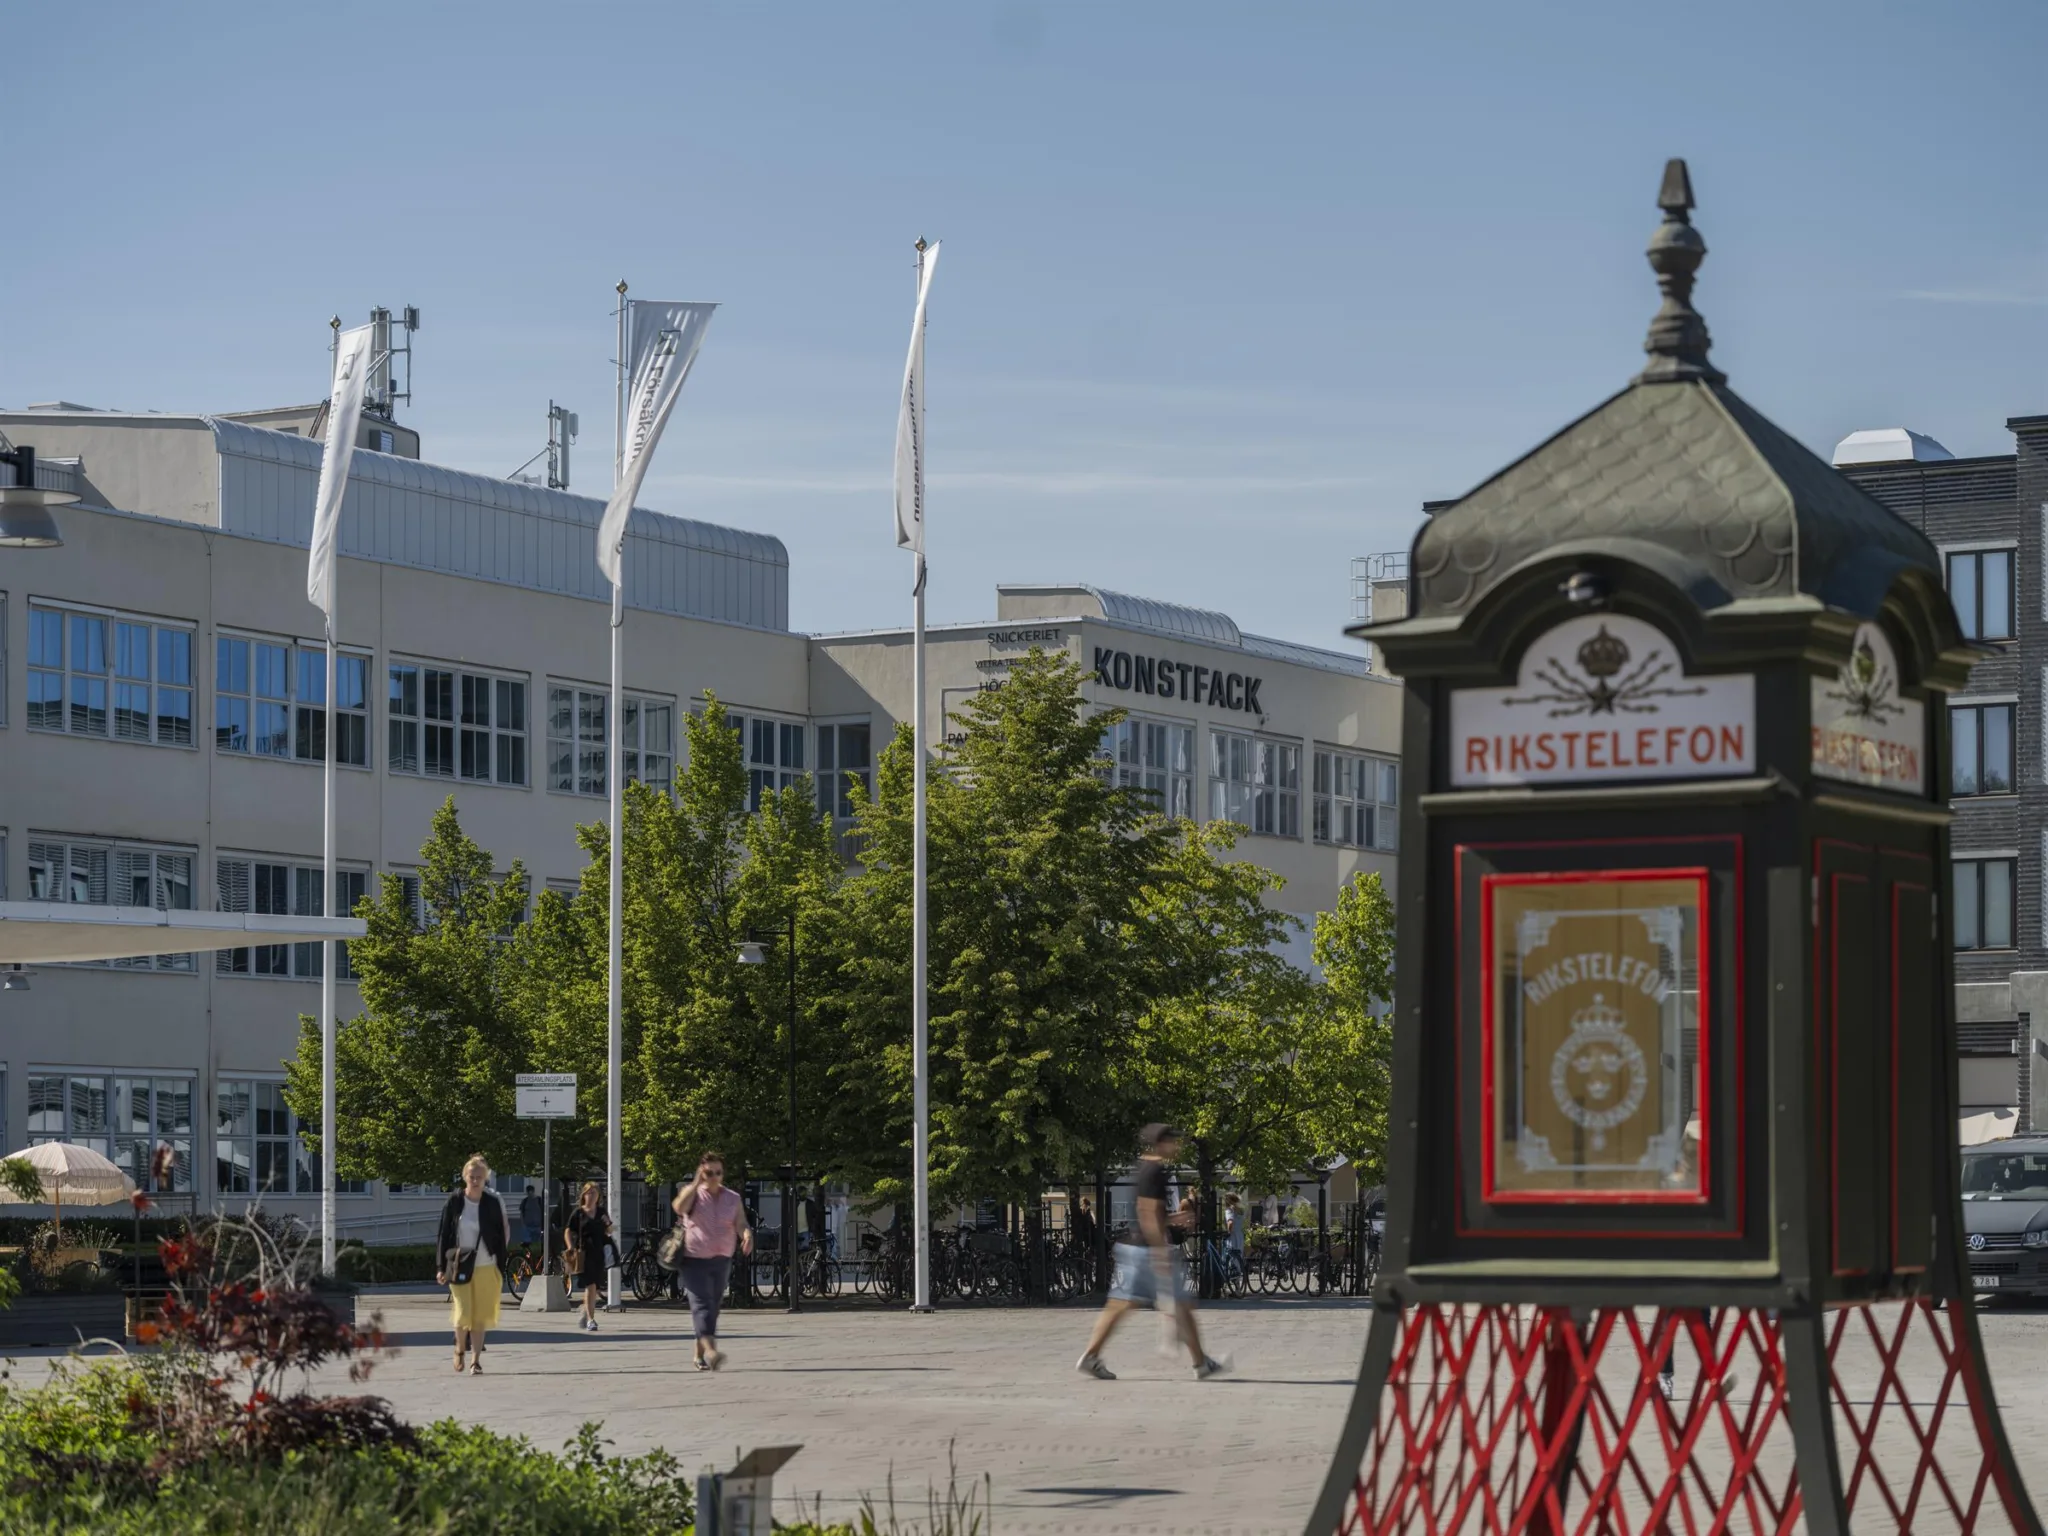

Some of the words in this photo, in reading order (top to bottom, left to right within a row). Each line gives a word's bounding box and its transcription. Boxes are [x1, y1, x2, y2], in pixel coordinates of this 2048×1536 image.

[987, 629, 1061, 644] SNICKERIET
[1094, 647, 1263, 715] KONSTFACK
[1465, 724, 1745, 774] RIKSTELEFON
[1523, 952, 1675, 1005] RIKSTELEFON
